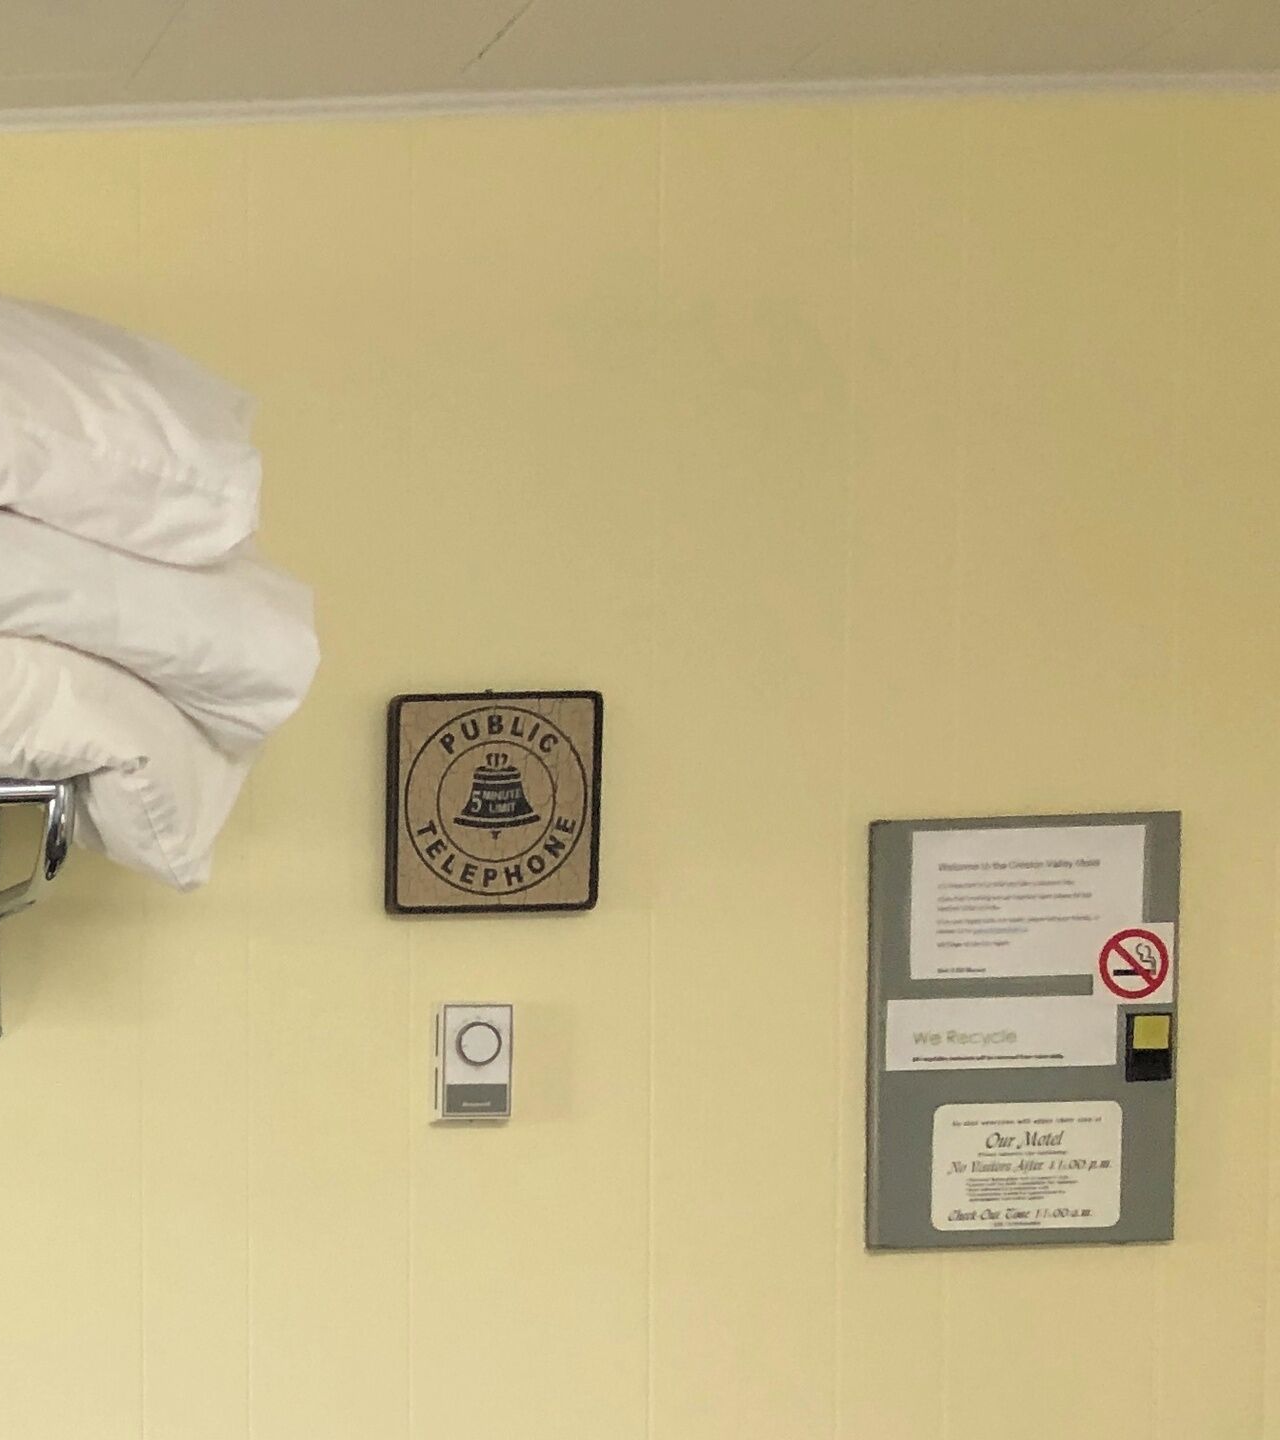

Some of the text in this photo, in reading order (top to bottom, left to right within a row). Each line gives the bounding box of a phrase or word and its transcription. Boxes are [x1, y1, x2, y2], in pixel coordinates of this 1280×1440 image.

[440, 715, 558, 754] PUBLIC
[471, 790, 482, 812] 5
[489, 802, 515, 813] LIMIT
[417, 816, 576, 887] TELEPHONE
[913, 1029, 1017, 1046] We Recycle
[985, 1130, 1065, 1149] Our Motel
